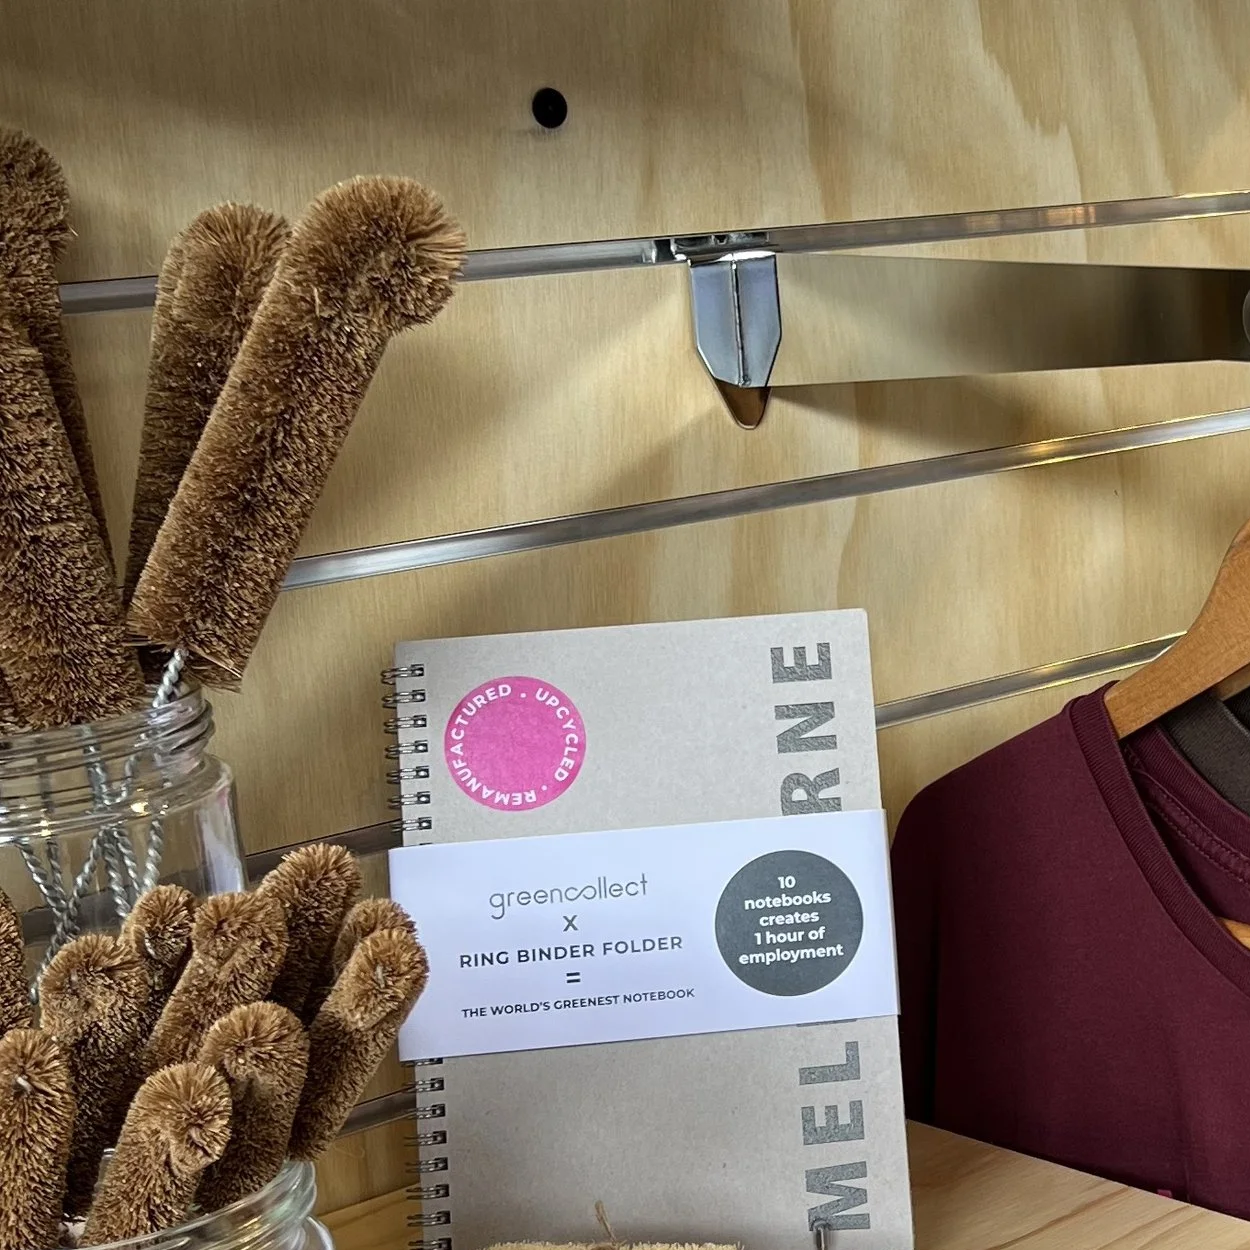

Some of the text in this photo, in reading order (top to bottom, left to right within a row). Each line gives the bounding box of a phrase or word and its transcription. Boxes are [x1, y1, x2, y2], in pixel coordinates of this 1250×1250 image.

[450, 684, 537, 806] REMANUFACTURED
[535, 687, 579, 782] UPCYCLED
[778, 875, 796, 889] 10
[489, 873, 648, 920] greencollect
[744, 891, 832, 910] notebooks
[759, 911, 820, 926] creates
[754, 926, 826, 945] 1 hour of
[459, 936, 683, 968] RING BINDER FOLDER
[738, 944, 844, 965] employment
[461, 988, 695, 1018] THE WORLD'S GREENEST NOTEBOOK
